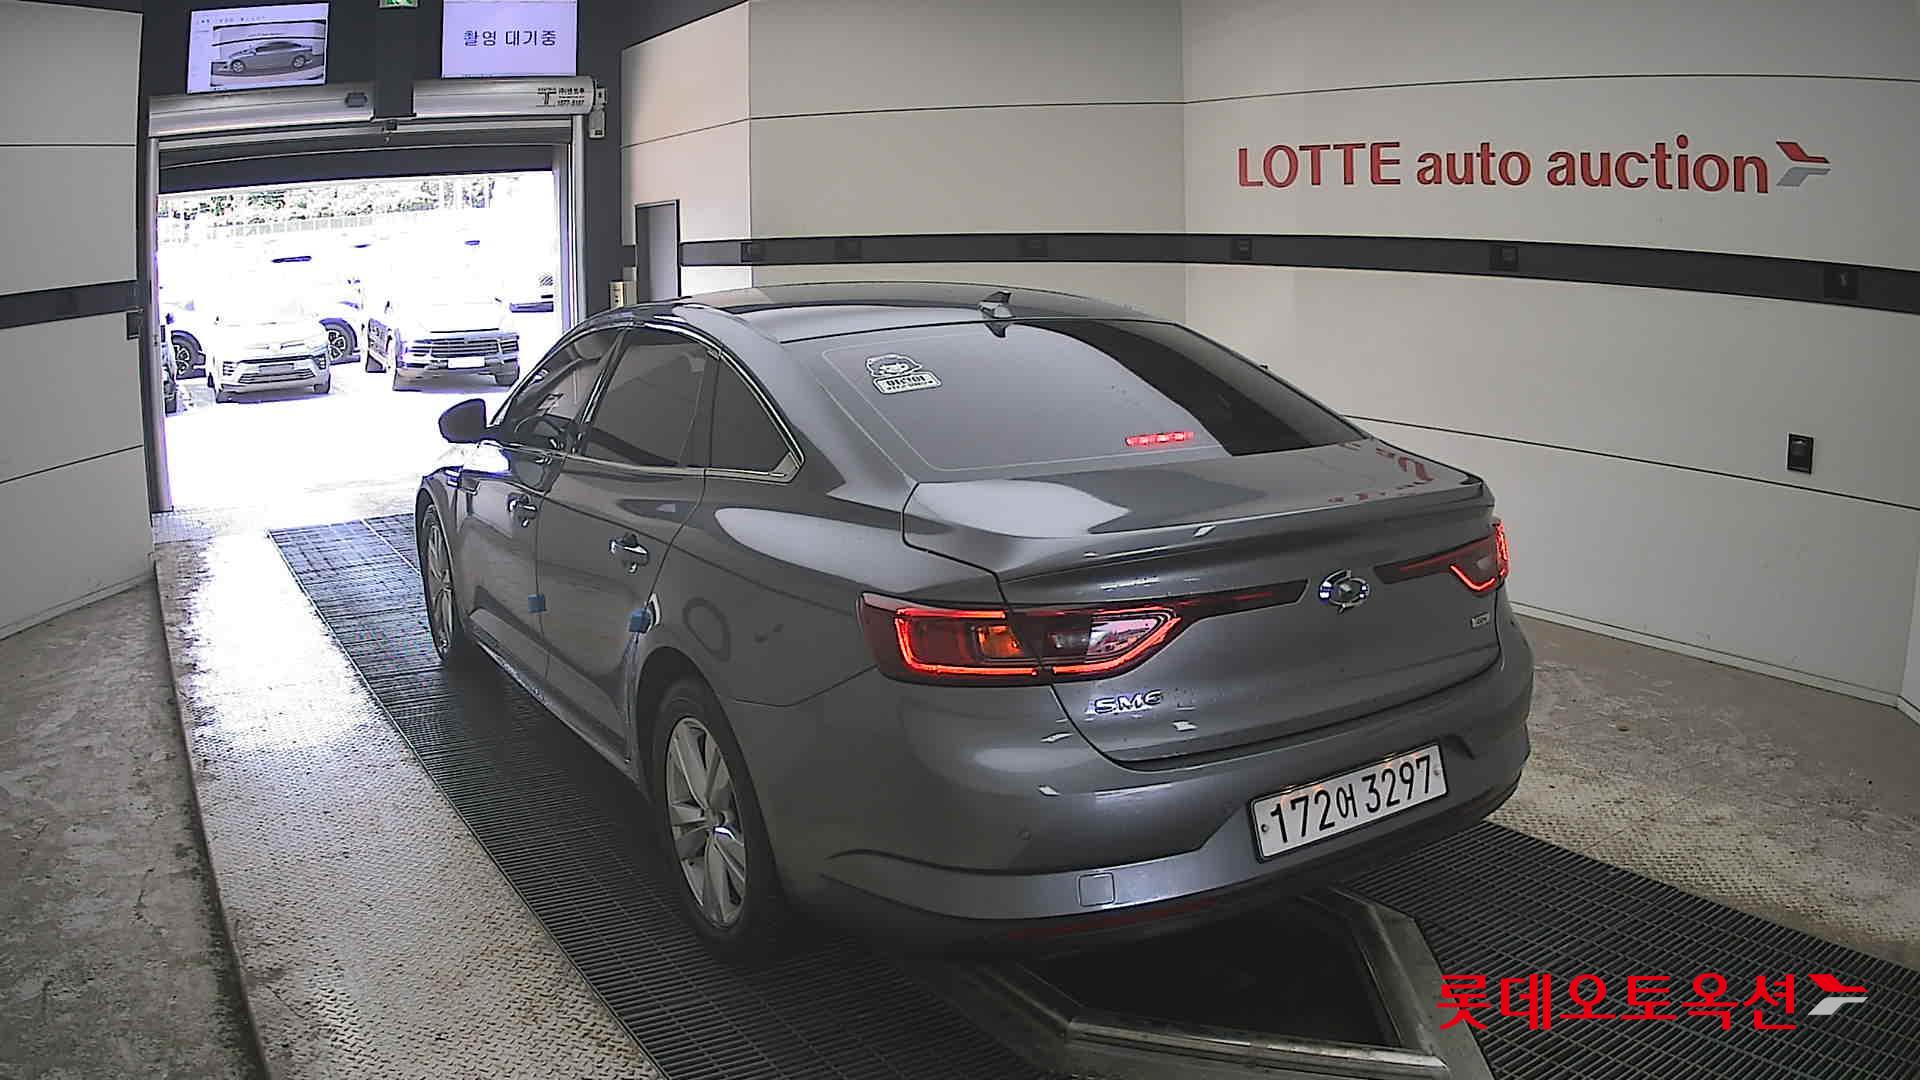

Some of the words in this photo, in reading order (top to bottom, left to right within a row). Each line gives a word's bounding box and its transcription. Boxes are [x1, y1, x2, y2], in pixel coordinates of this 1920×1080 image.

[463, 29, 497, 47] 촬영
[505, 29, 557, 47] 대기중
[1237, 141, 1401, 188] LOTTE
[1415, 141, 1531, 187] auto
[1546, 134, 1769, 195] auction
[1094, 689, 1163, 714] SM6
